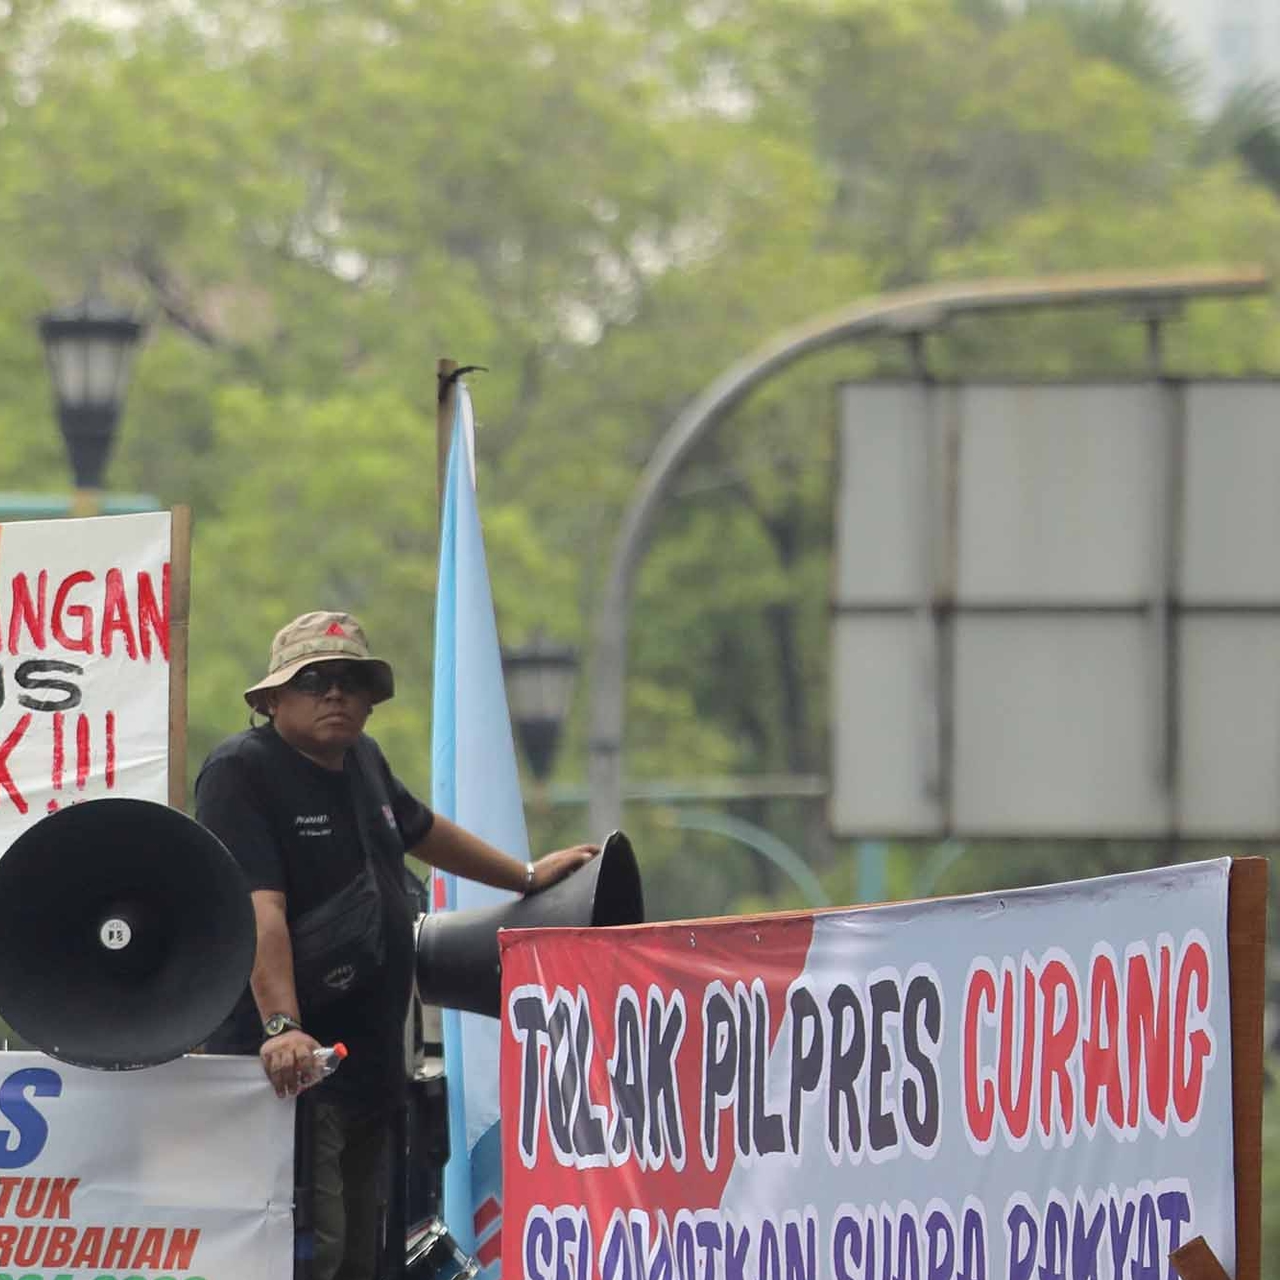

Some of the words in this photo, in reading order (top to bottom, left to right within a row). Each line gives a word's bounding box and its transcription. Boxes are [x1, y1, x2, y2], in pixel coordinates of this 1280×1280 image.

[509, 984, 688, 1171] TOLAK
[701, 963, 942, 1171] PILPRES
[962, 929, 1214, 1155] CURANG
